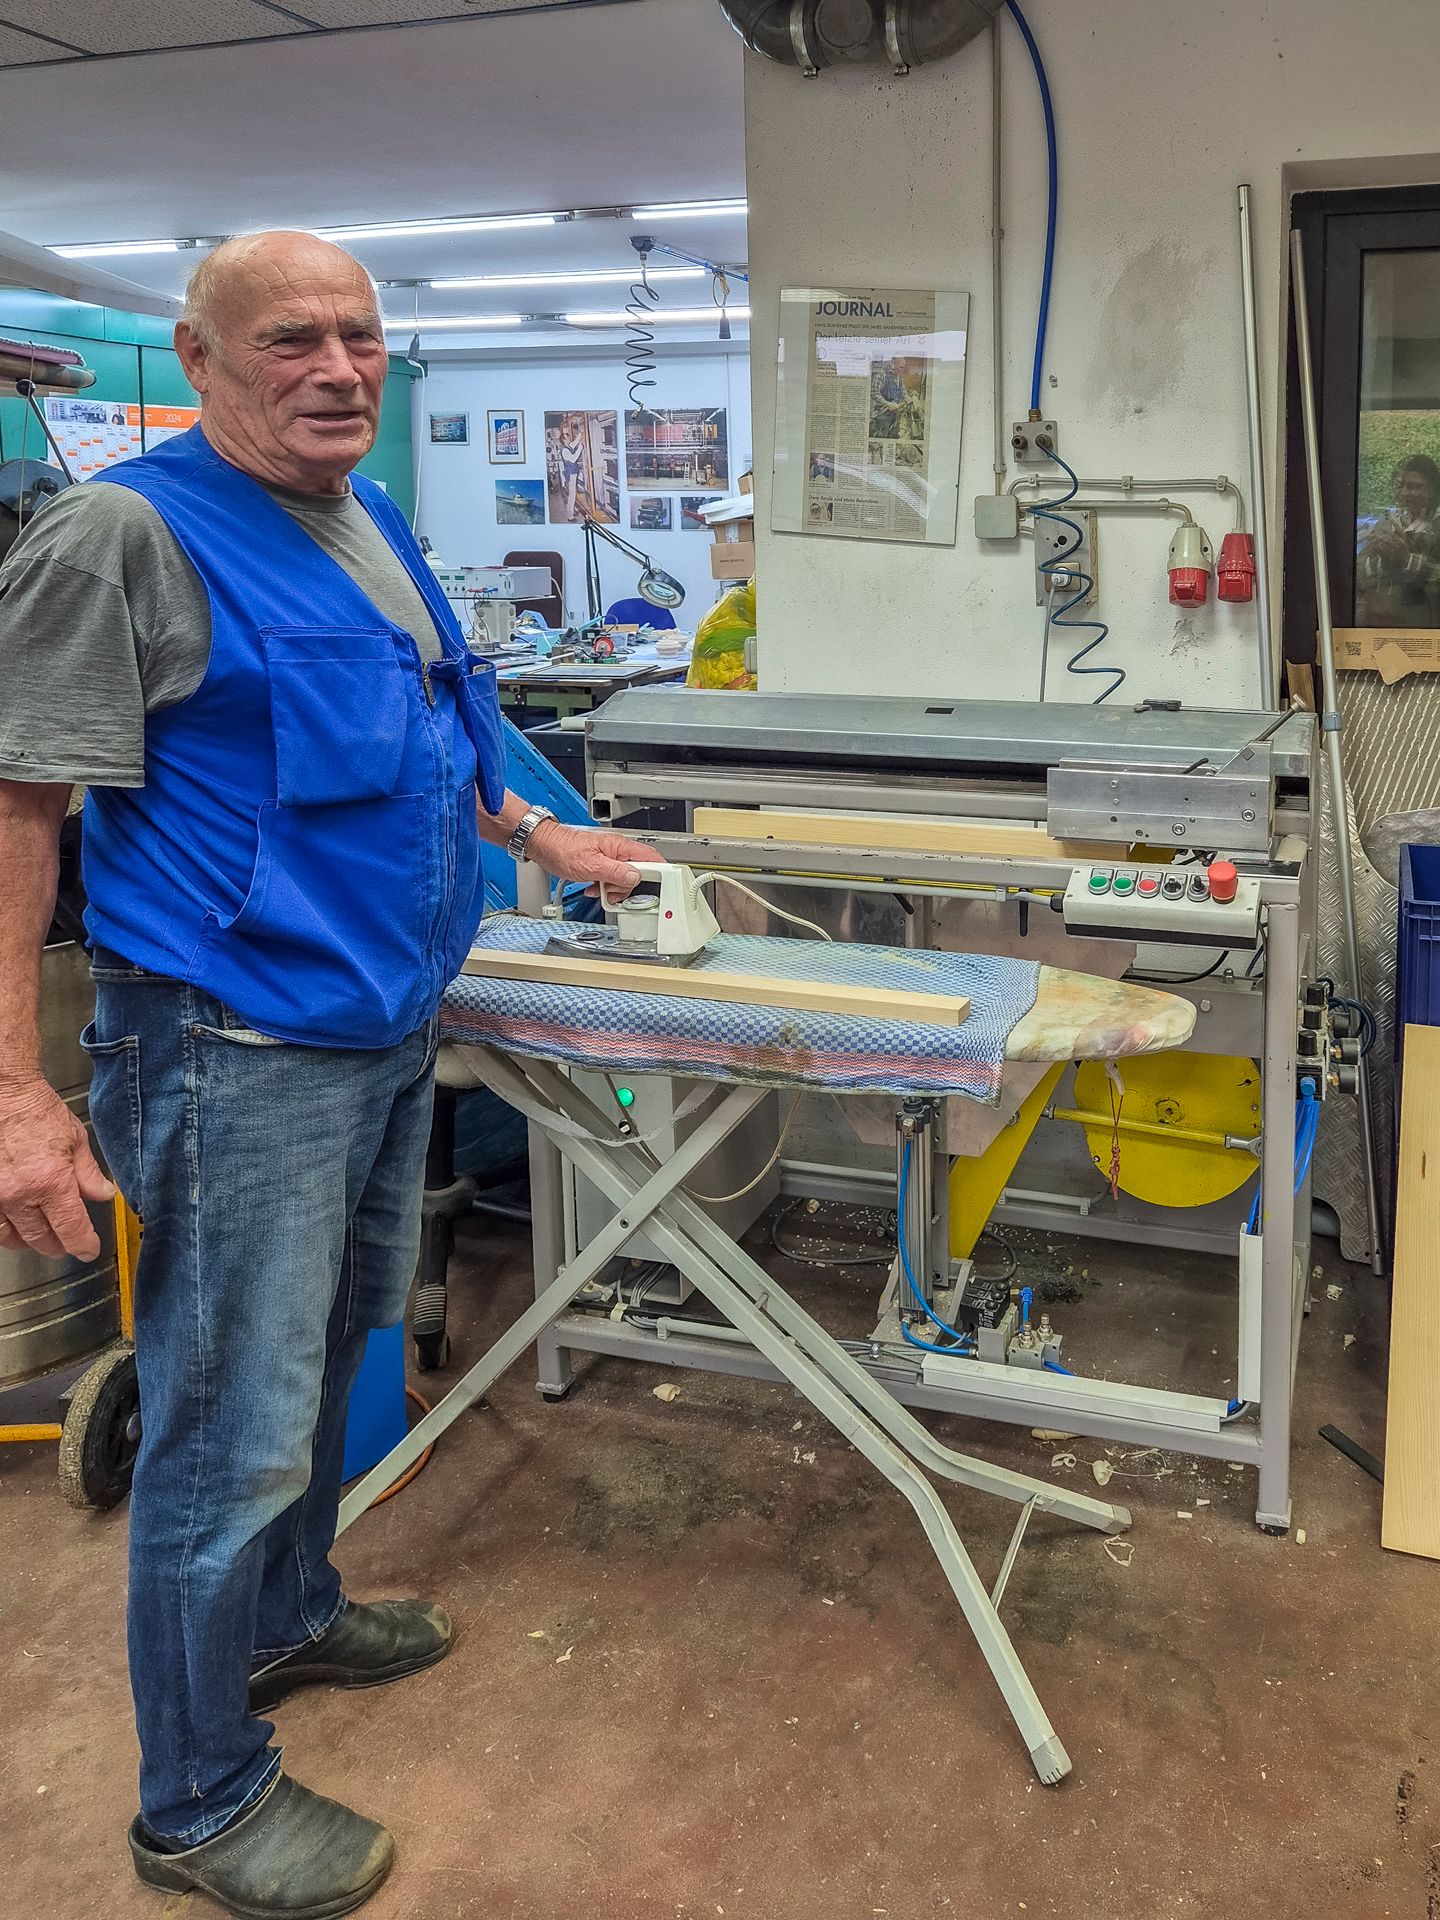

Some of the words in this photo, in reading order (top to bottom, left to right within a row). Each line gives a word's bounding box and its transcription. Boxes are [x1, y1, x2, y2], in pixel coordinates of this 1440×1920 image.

[816, 301, 893, 317] JOURNAL
[815, 331, 832, 342] Der
[835, 331, 861, 343] Letzte
[864, 333, 891, 345] seiner
[164, 413, 182, 423] 2024
